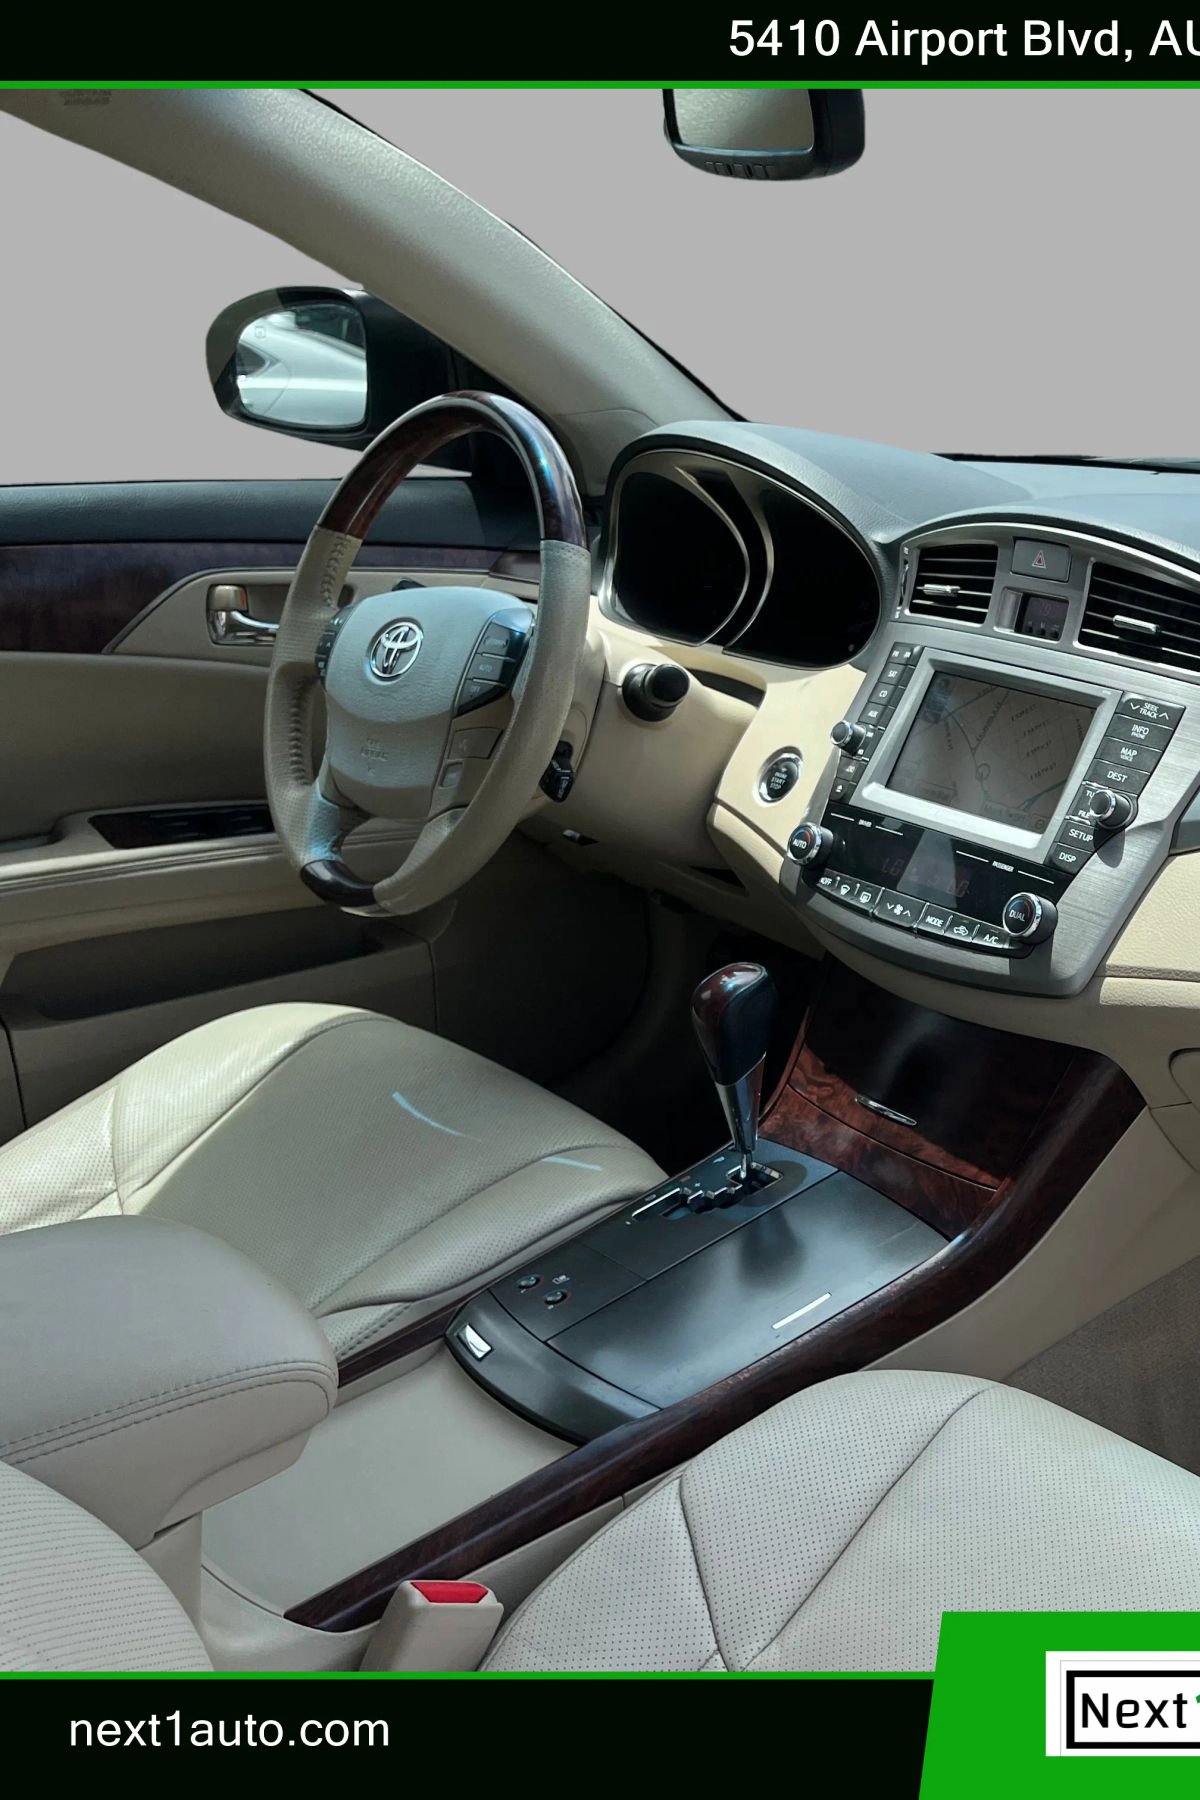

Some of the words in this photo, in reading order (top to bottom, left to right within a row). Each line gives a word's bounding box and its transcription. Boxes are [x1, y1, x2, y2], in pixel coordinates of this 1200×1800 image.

[1143, 702, 1160, 712] SEEK
[1139, 708, 1158, 719] TRACK
[1131, 724, 1150, 735] INFO
[1120, 747, 1138, 757] MAP
[1106, 770, 1128, 783] DEST
[1068, 828, 1094, 842] SETUP
[792, 838, 807, 849] AUTO
[1058, 852, 1077, 863] DISP
[1008, 909, 1026, 922] DUAL
[925, 915, 944, 928] MODE
[983, 933, 999, 945] A/C
